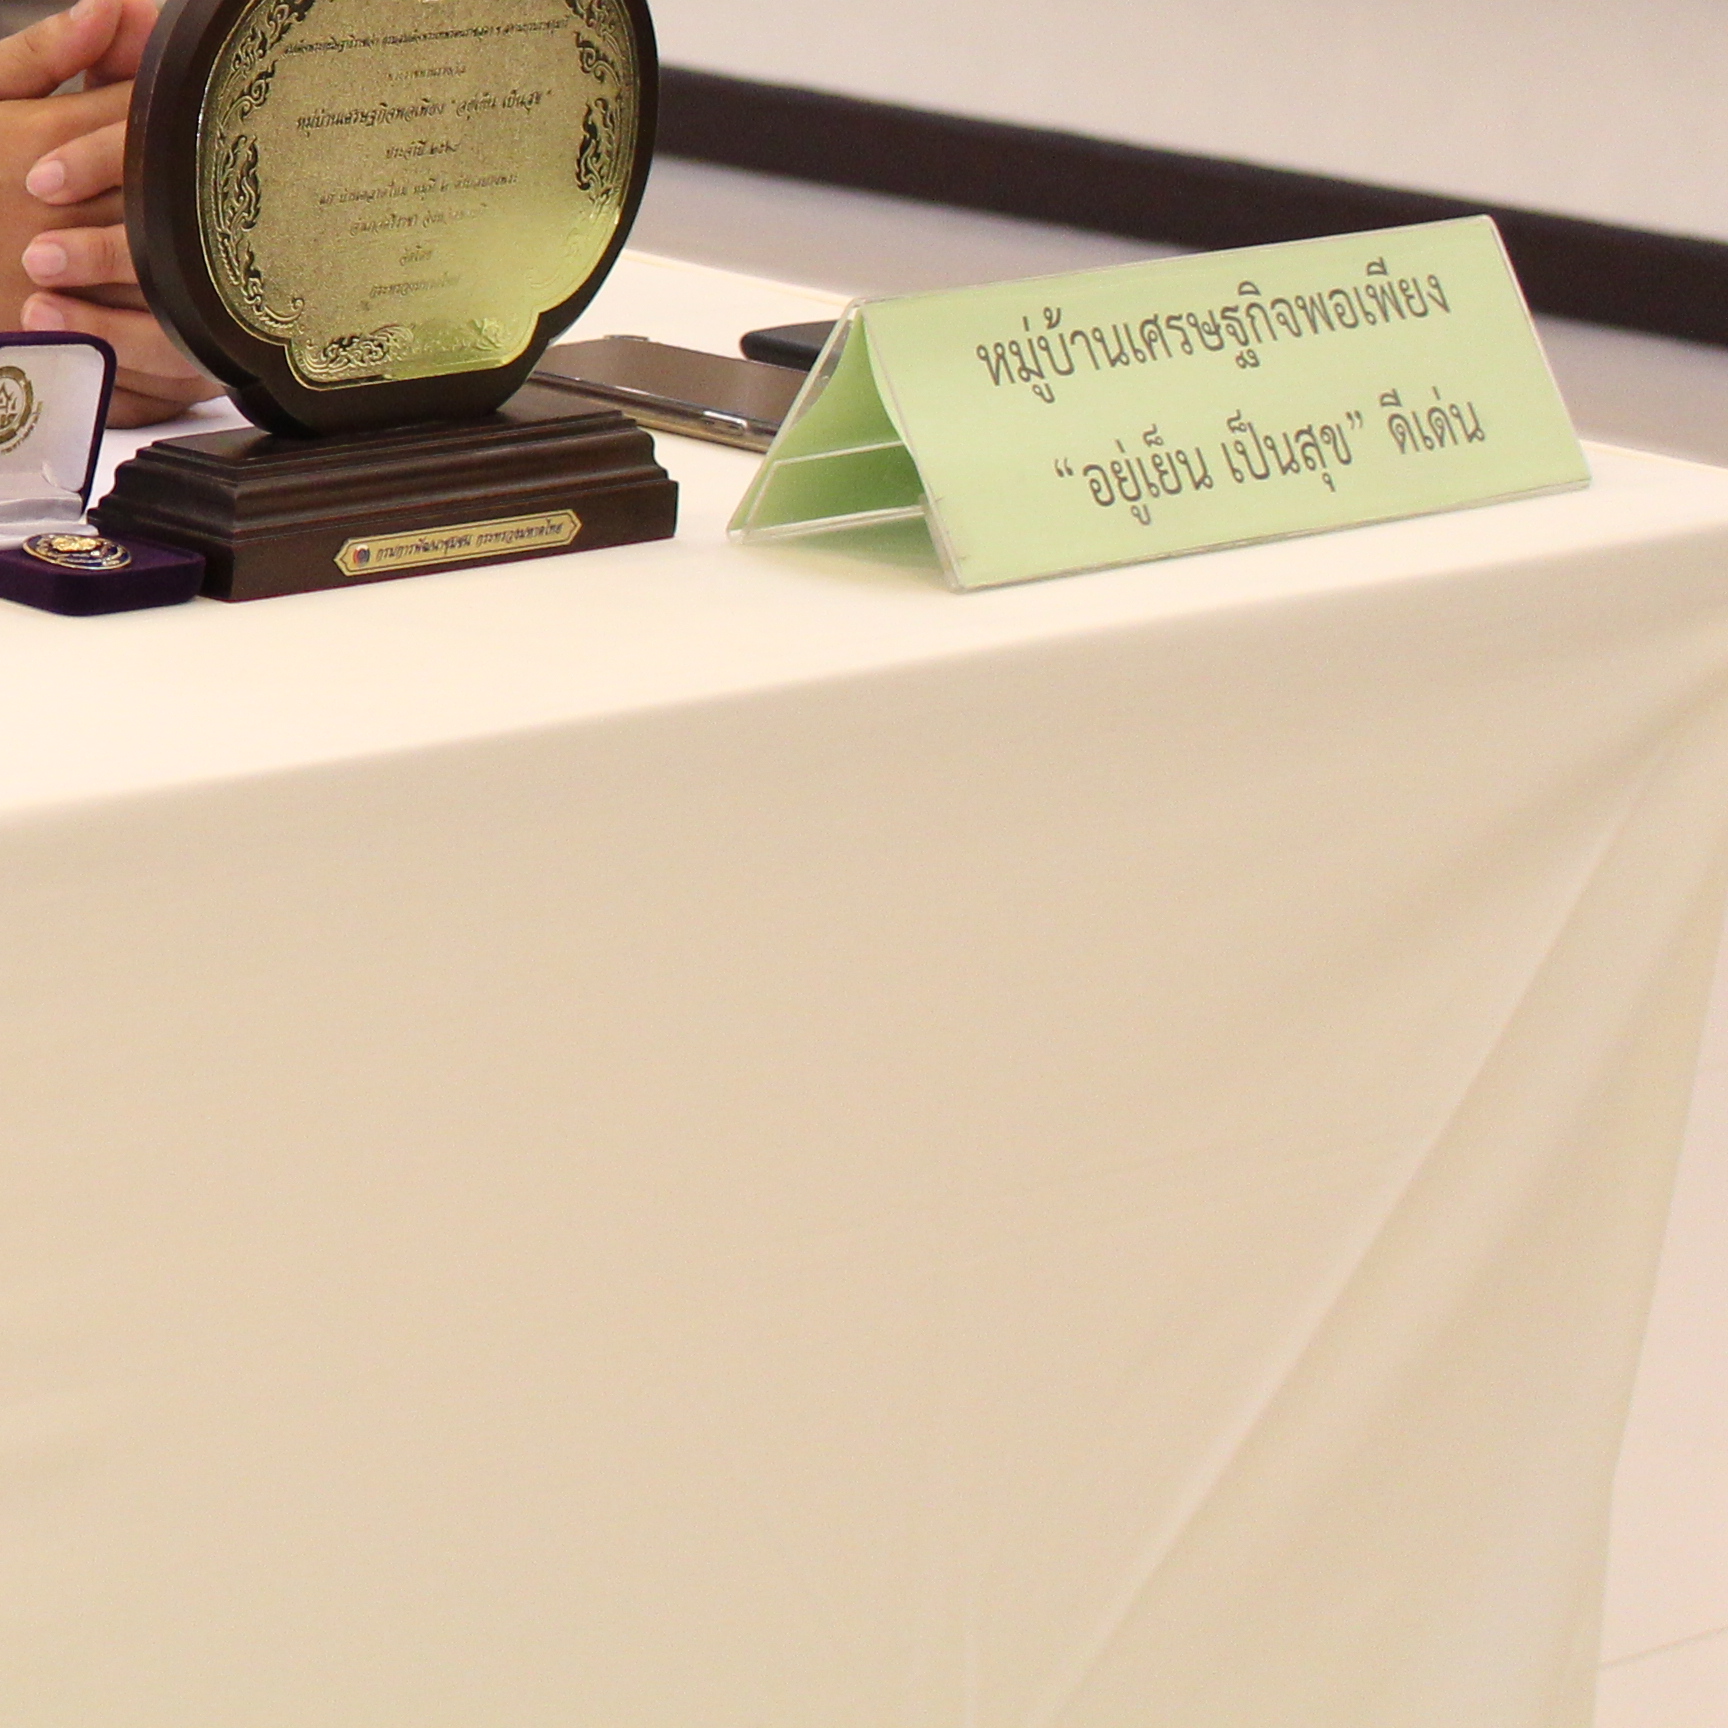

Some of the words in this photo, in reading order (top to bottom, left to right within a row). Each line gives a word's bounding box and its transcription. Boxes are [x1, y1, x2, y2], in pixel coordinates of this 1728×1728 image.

[976, 256, 1452, 404] หมู่บ้านเศรษฐกิจพอเพียง
[1054, 425, 1212, 526] “อยู่เย็น
[1222, 409, 1366, 493] เป็นสุข”
[1378, 389, 1487, 458] ดีเด่น
